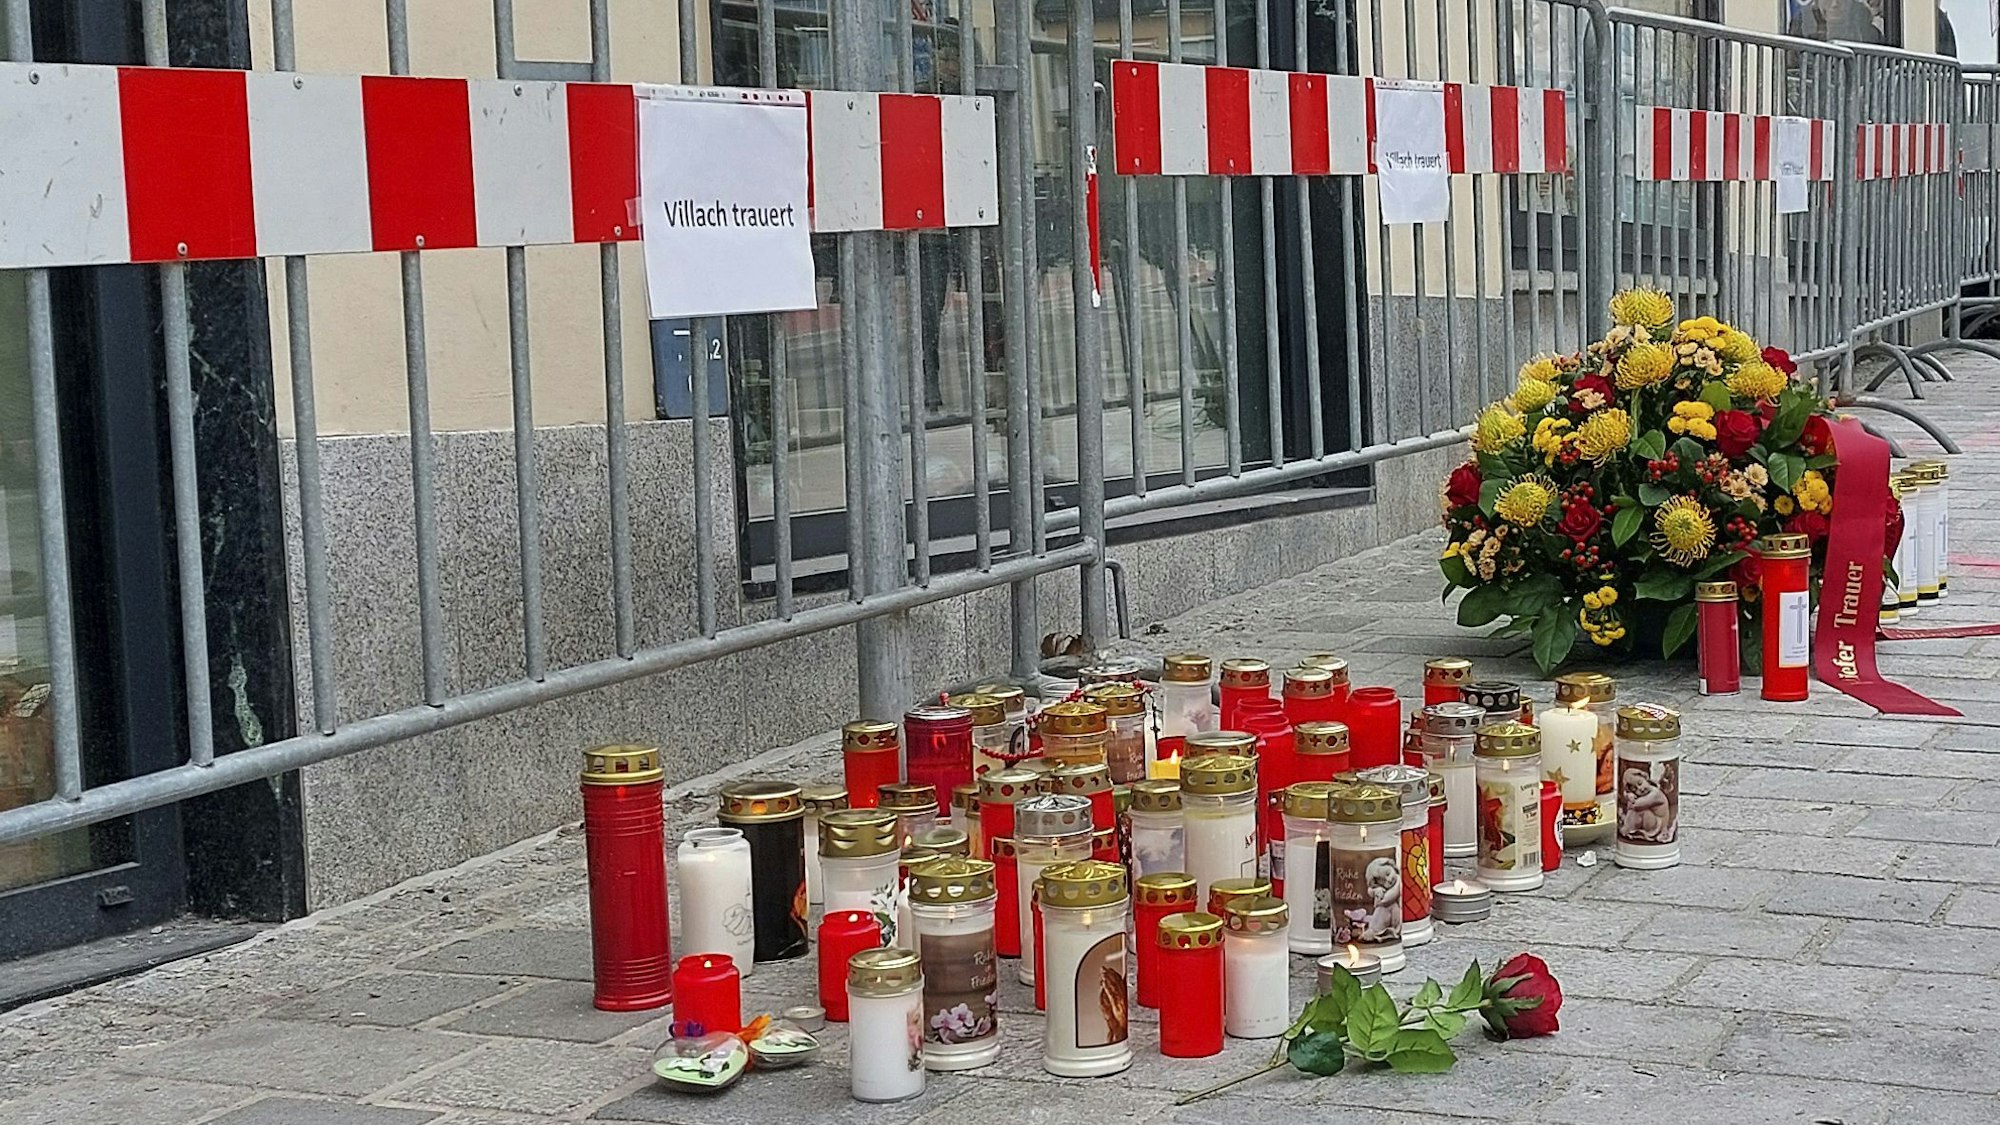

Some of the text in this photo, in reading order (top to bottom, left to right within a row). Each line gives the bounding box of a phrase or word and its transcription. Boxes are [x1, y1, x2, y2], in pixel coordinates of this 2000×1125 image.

[1414, 152, 1442, 169] trauert
[664, 200, 795, 228] Villach trauert
[1832, 561, 1863, 683] iefer Trauer
[1336, 867, 1359, 880] Ruhe
